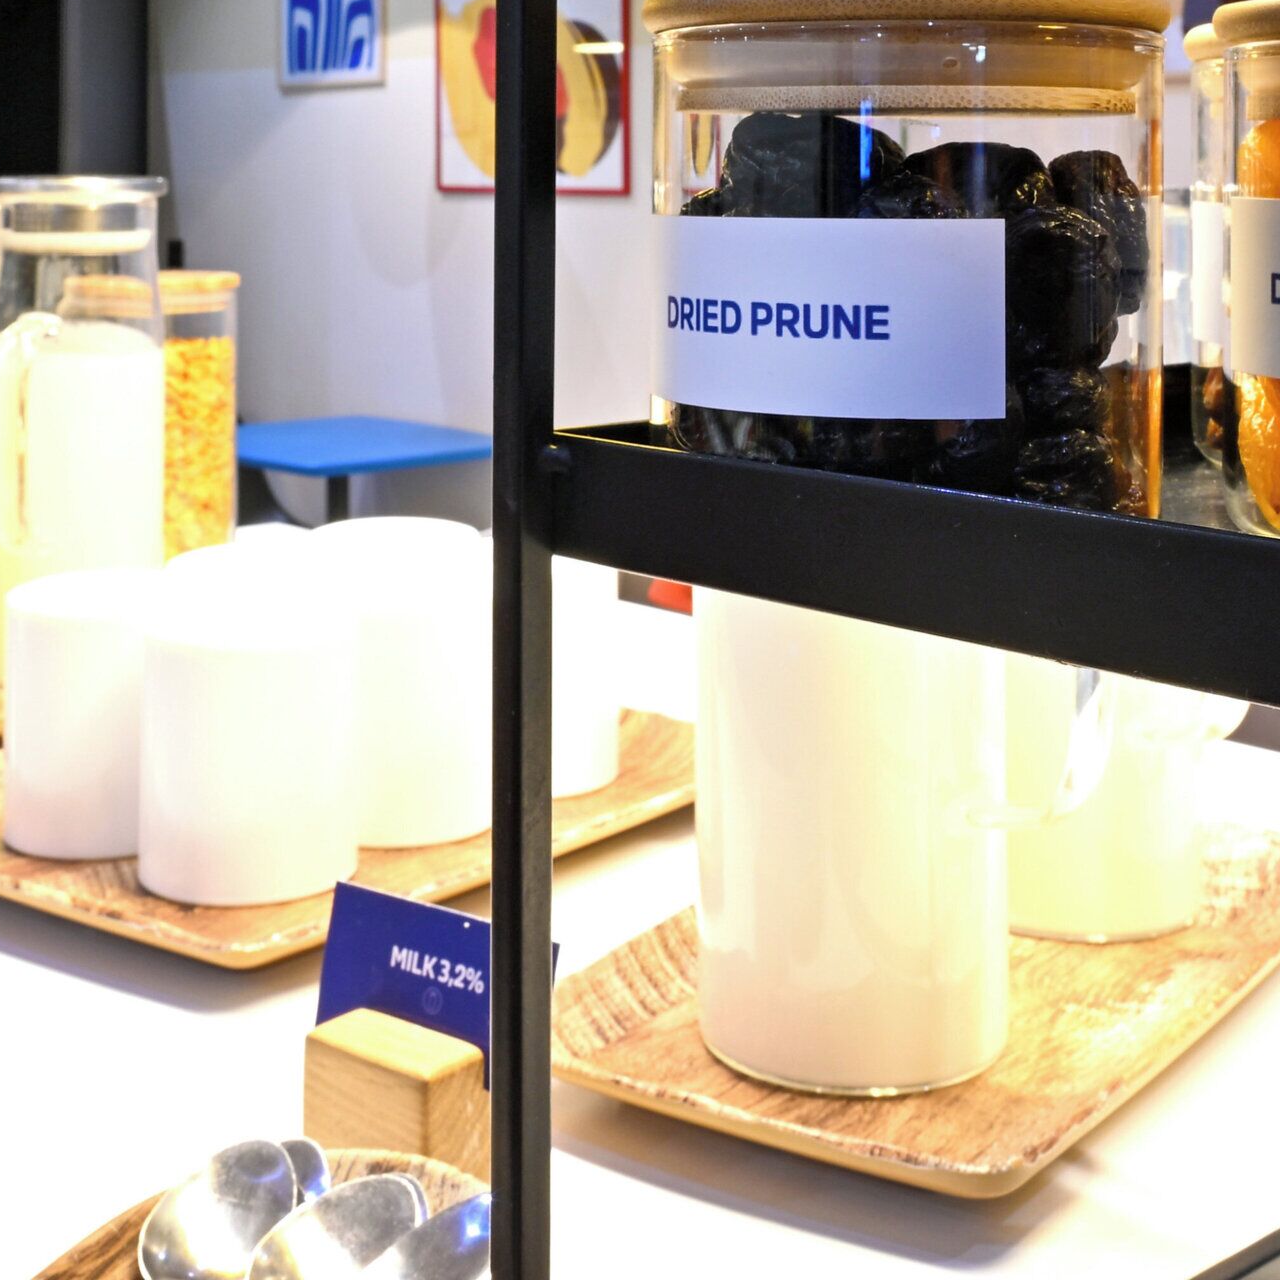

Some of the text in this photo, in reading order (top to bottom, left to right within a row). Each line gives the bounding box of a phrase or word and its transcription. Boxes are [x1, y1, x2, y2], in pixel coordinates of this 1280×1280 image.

[667, 296, 890, 340] DRIED PRUNE
[390, 945, 484, 994] MILK 3,2%
